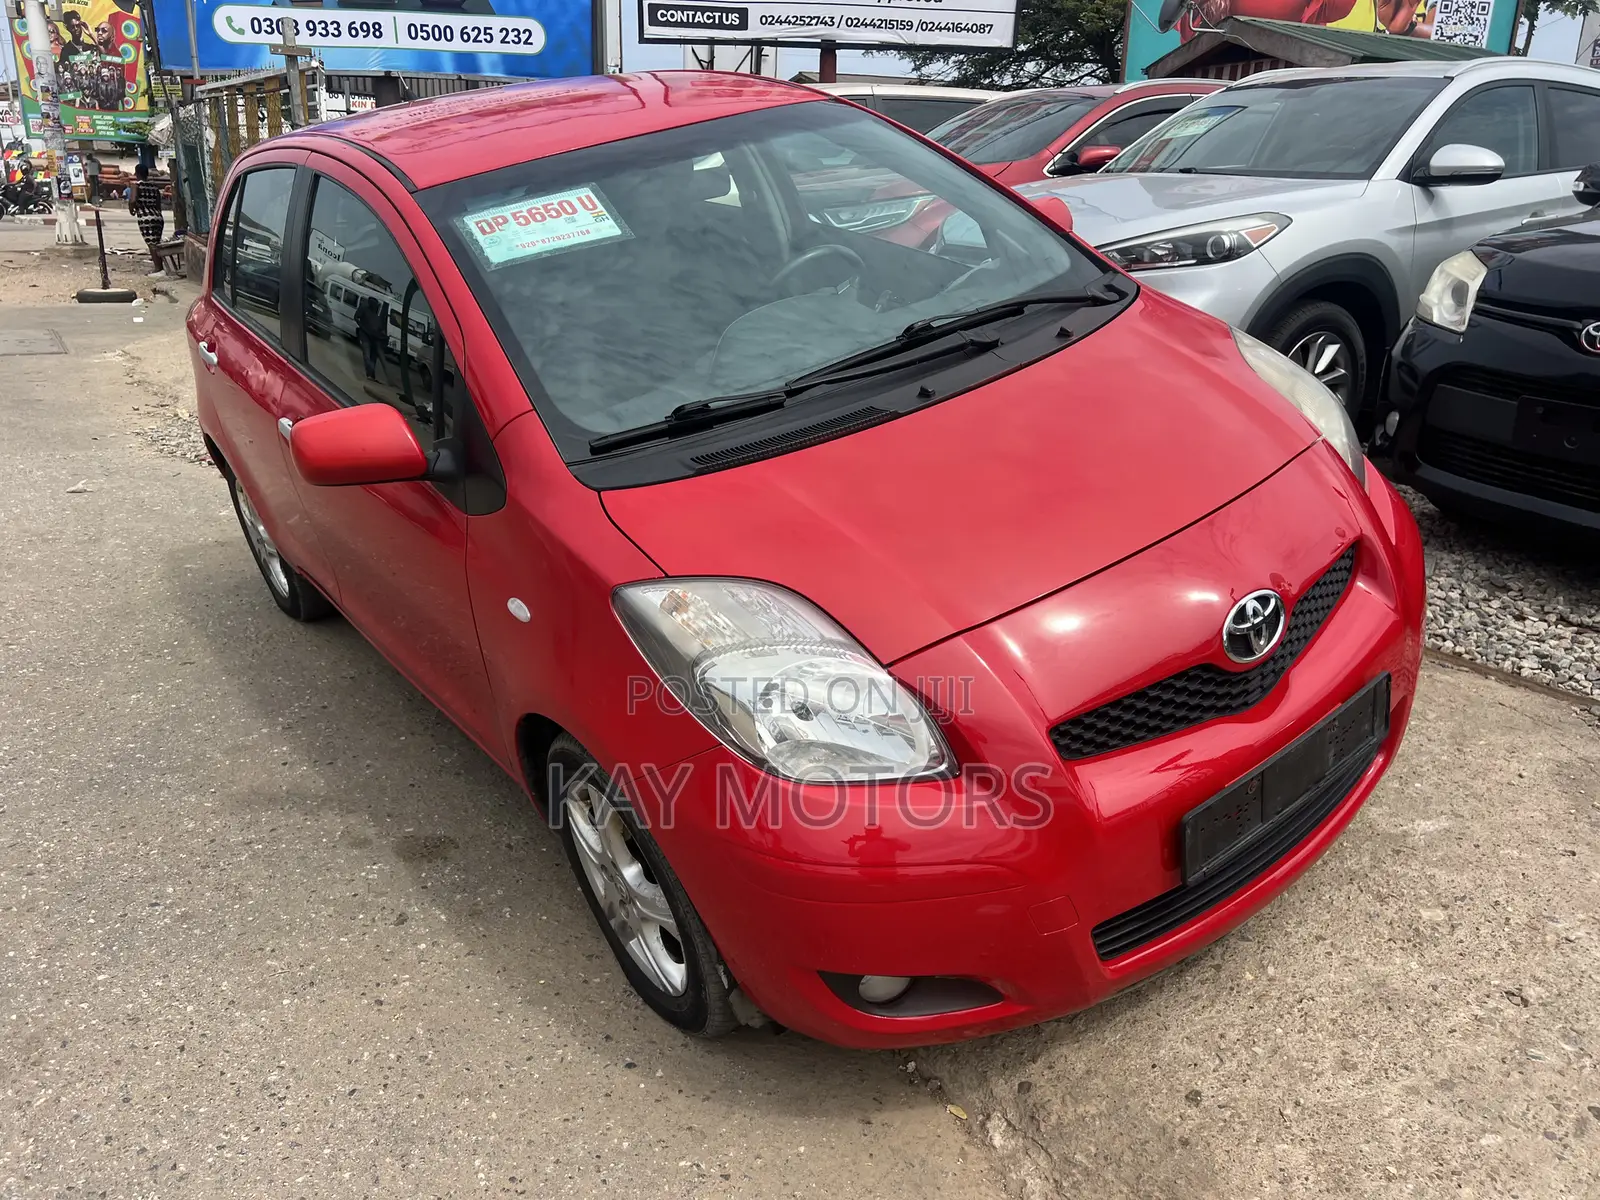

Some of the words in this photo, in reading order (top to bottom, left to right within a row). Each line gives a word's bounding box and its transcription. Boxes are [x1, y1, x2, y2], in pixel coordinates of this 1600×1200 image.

[657, 9, 721, 24] CONTACT
[723, 12, 740, 25] US
[759, 15, 835, 28] 0244252743
[845, 16, 914, 31] 0244215159
[305, 20, 342, 38] 933
[347, 21, 383, 39] 698
[407, 23, 454, 42] 0500
[460, 26, 494, 44] 625
[499, 28, 534, 45] 232
[511, 199, 578, 227] 5650
[576, 194, 598, 211] U
